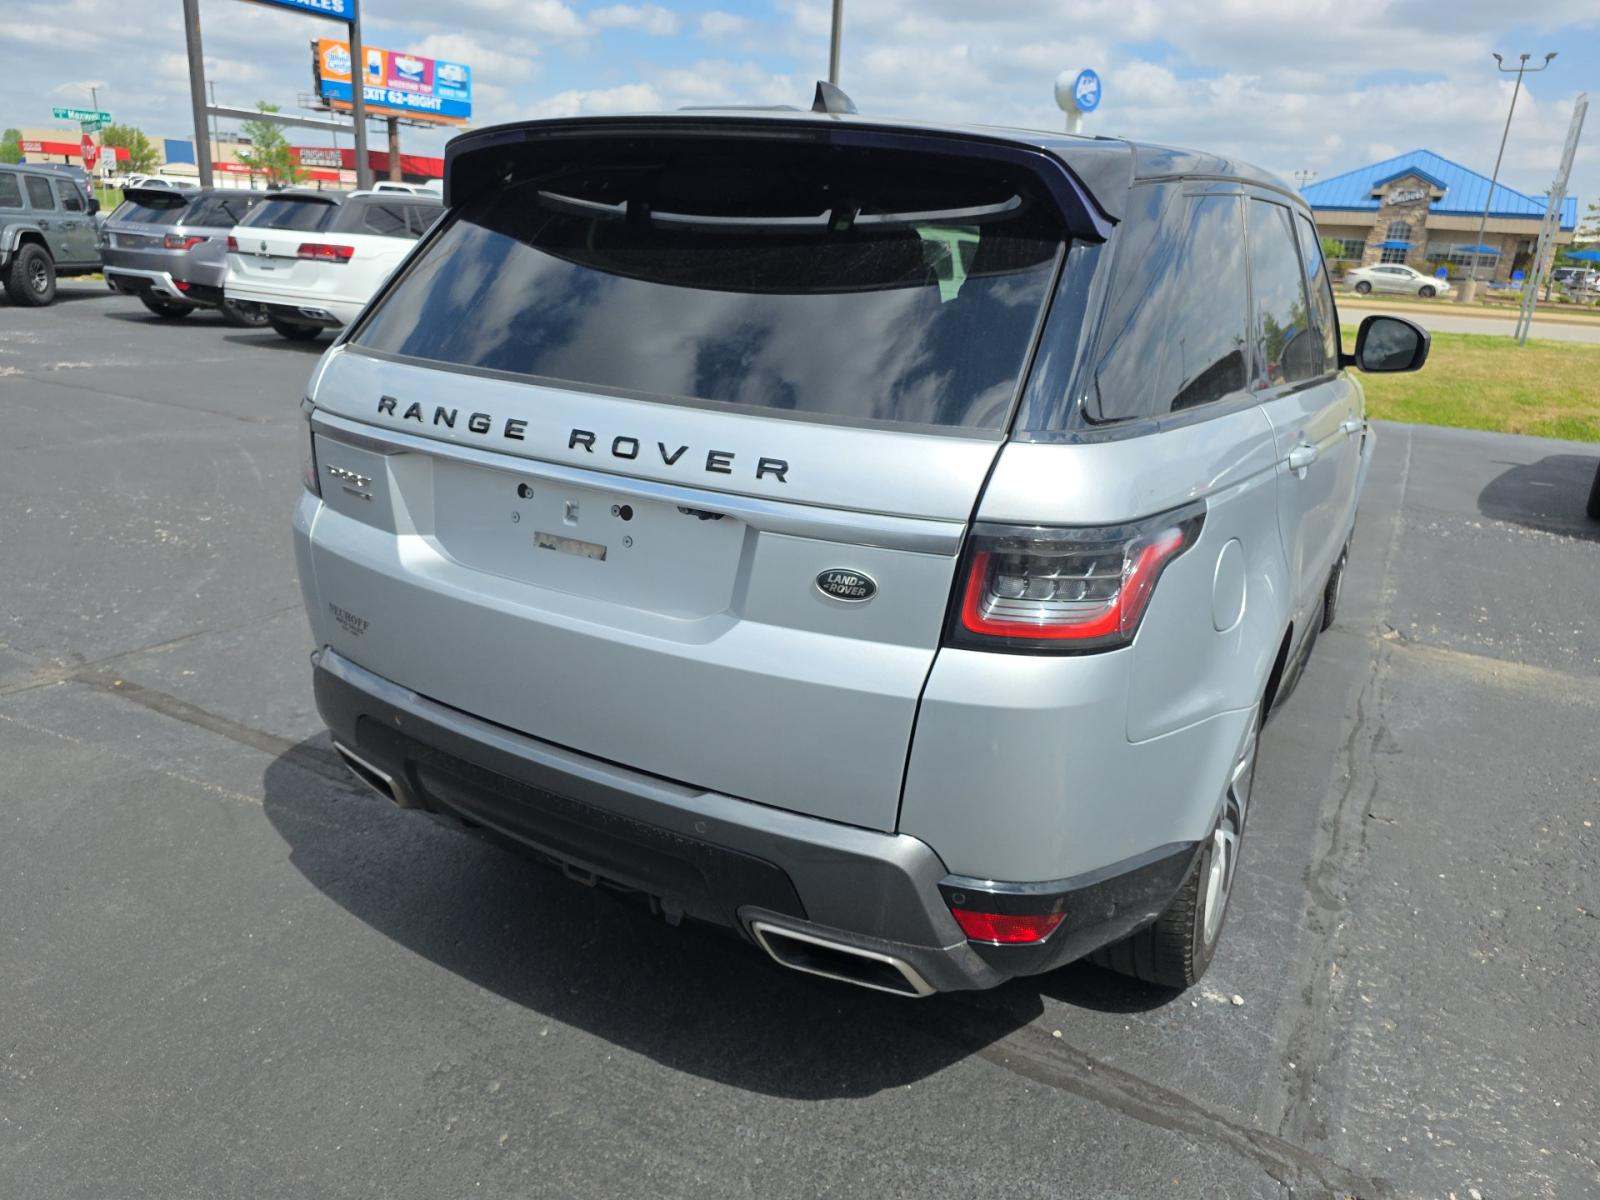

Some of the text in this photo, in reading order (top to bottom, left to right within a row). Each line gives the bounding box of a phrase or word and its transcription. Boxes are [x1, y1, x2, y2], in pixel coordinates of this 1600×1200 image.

[288, 0, 345, 13] LES
[363, 87, 386, 102] EXIT
[377, 395, 790, 483] RANGE ROVER
[827, 573, 858, 586] LAND
[828, 583, 866, 597] ROVER
